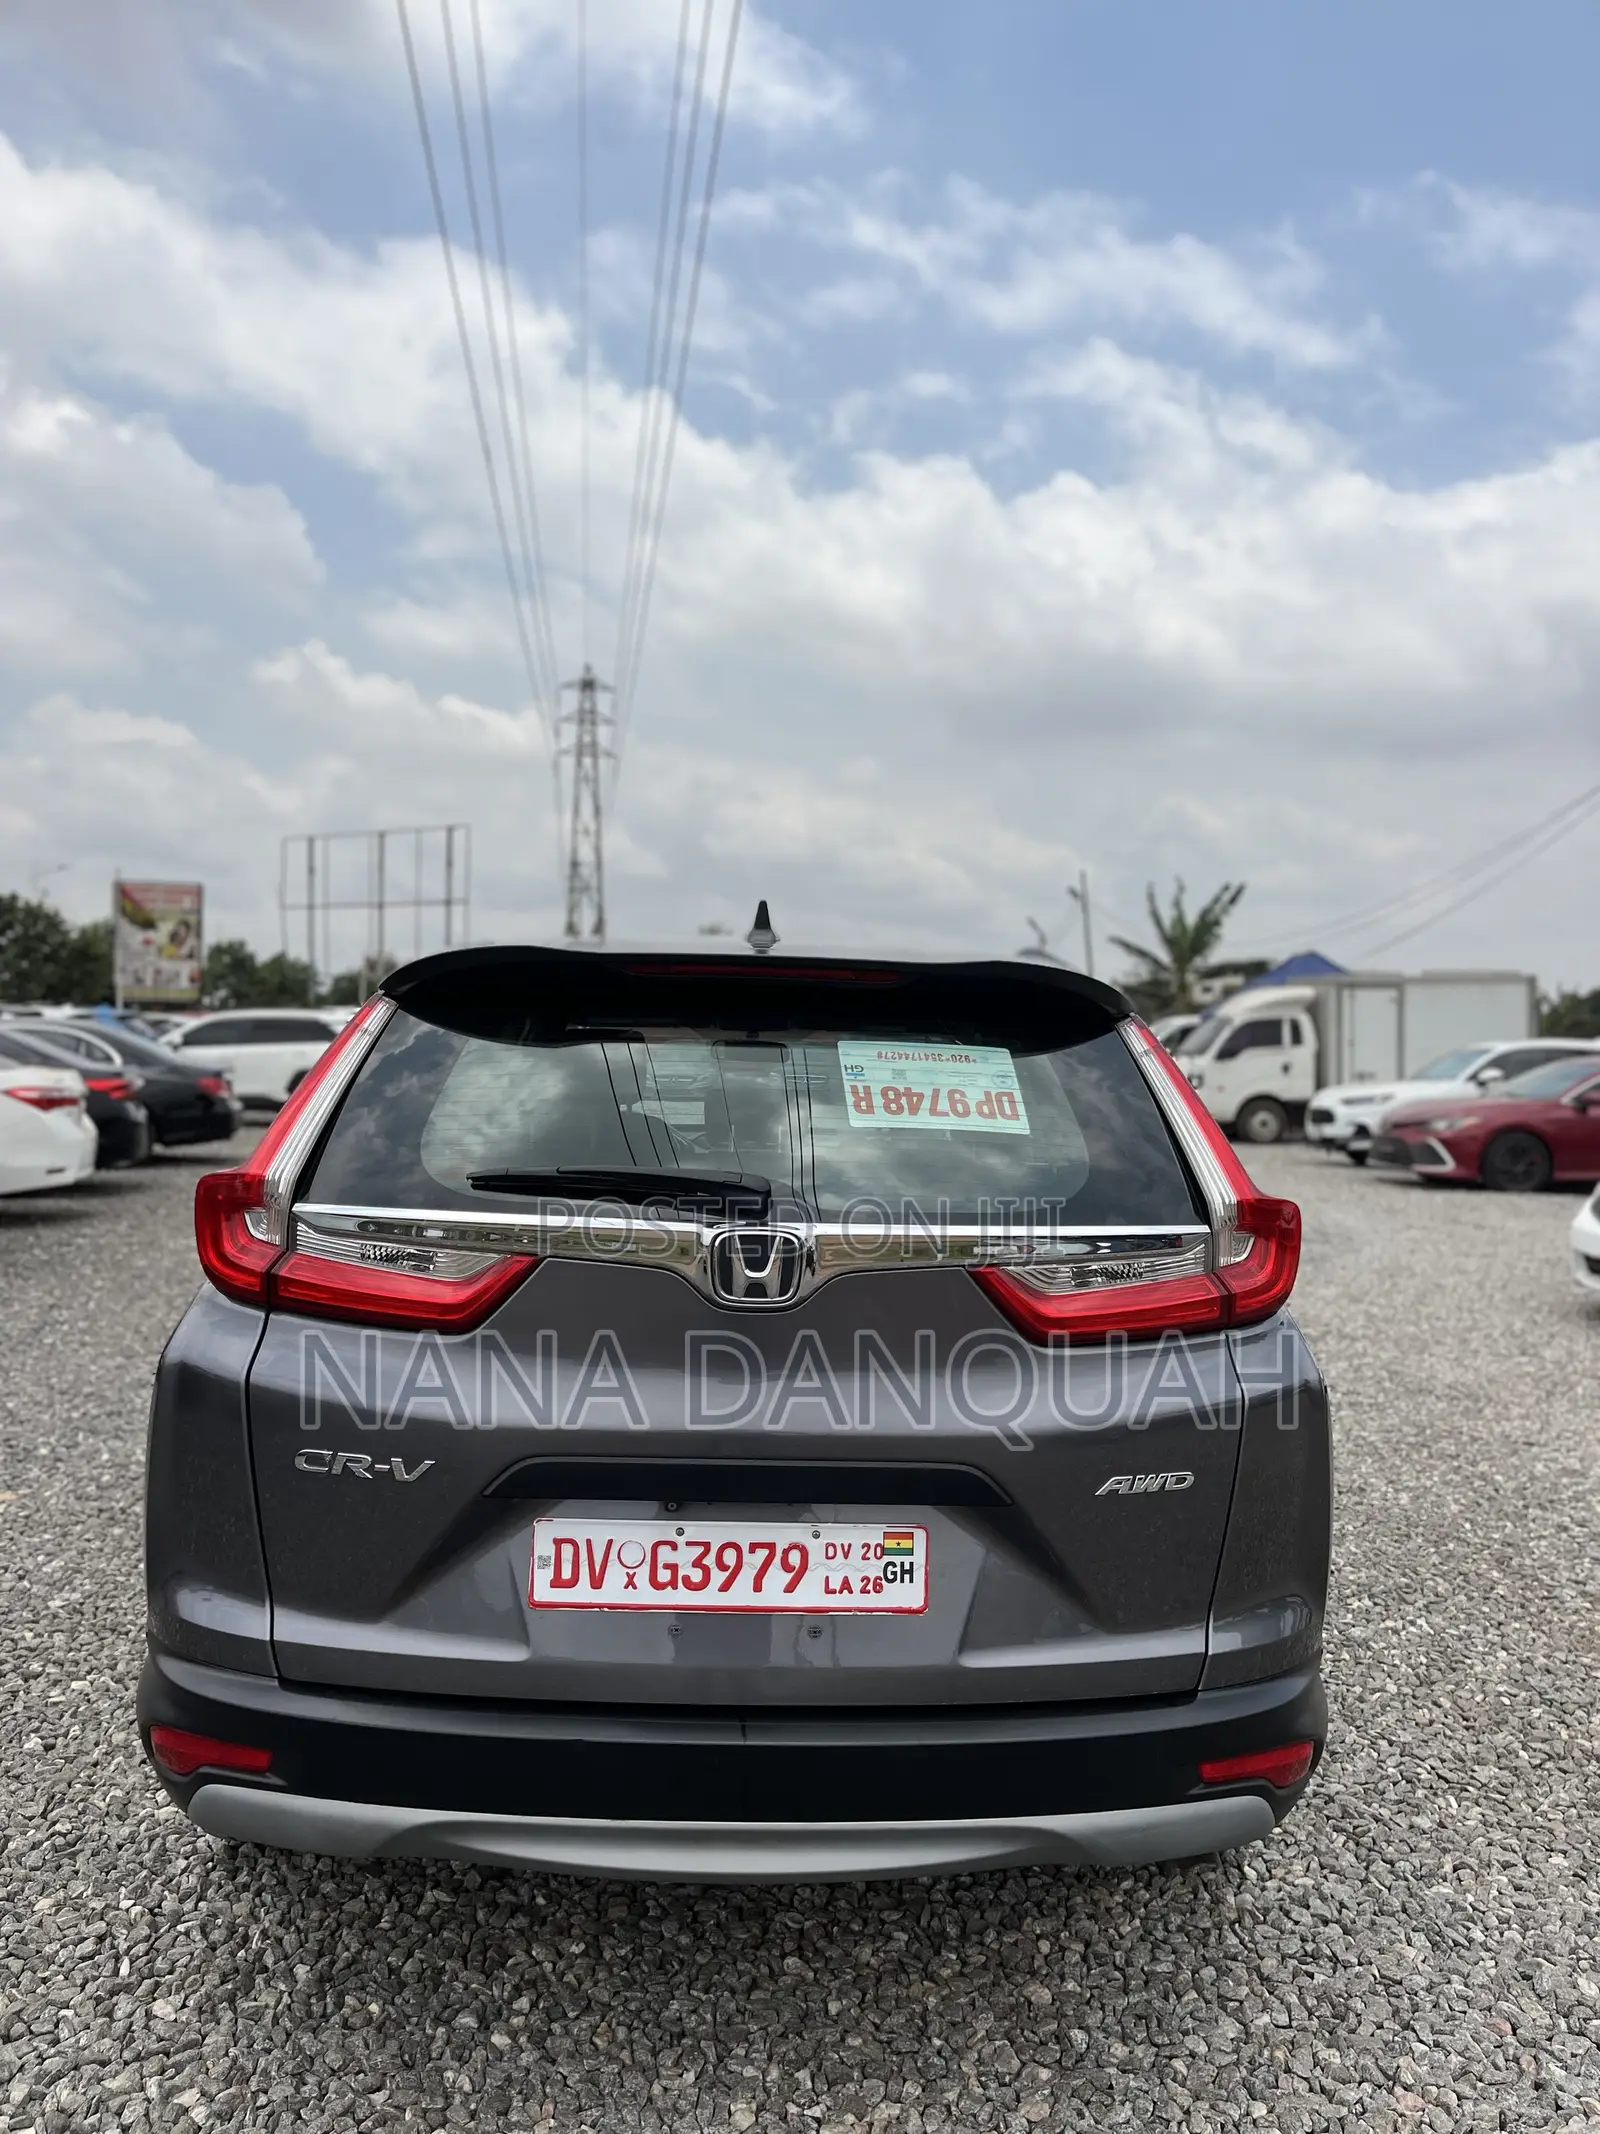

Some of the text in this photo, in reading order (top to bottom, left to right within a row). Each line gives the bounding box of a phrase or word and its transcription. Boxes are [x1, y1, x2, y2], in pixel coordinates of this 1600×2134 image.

[844, 1064, 864, 1073] GH
[849, 1084, 1020, 1121] DP 9748 R
[293, 1448, 436, 1483] CR-V
[1095, 1472, 1196, 1496] AWD
[824, 1542, 884, 1560] DV 20
[549, 1537, 614, 1590] DV
[648, 1539, 809, 1594] G3979
[882, 1561, 914, 1584] GH
[824, 1575, 884, 1594] LA 26
